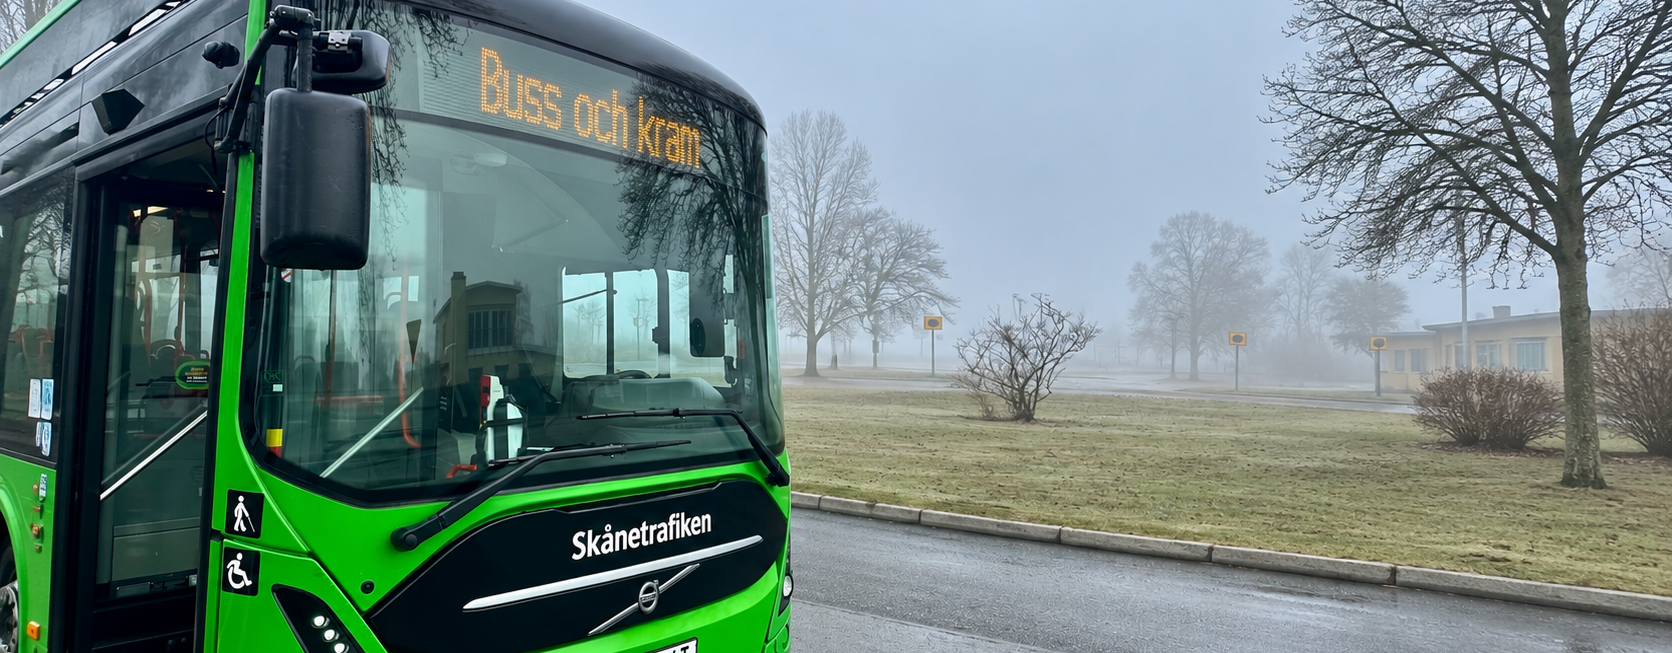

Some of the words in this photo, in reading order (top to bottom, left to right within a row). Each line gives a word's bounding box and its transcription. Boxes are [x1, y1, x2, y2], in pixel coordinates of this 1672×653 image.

[481, 47, 562, 130] Buss
[574, 89, 628, 149] och
[637, 96, 700, 169] kram
[571, 512, 712, 560] Skånetrafiken
